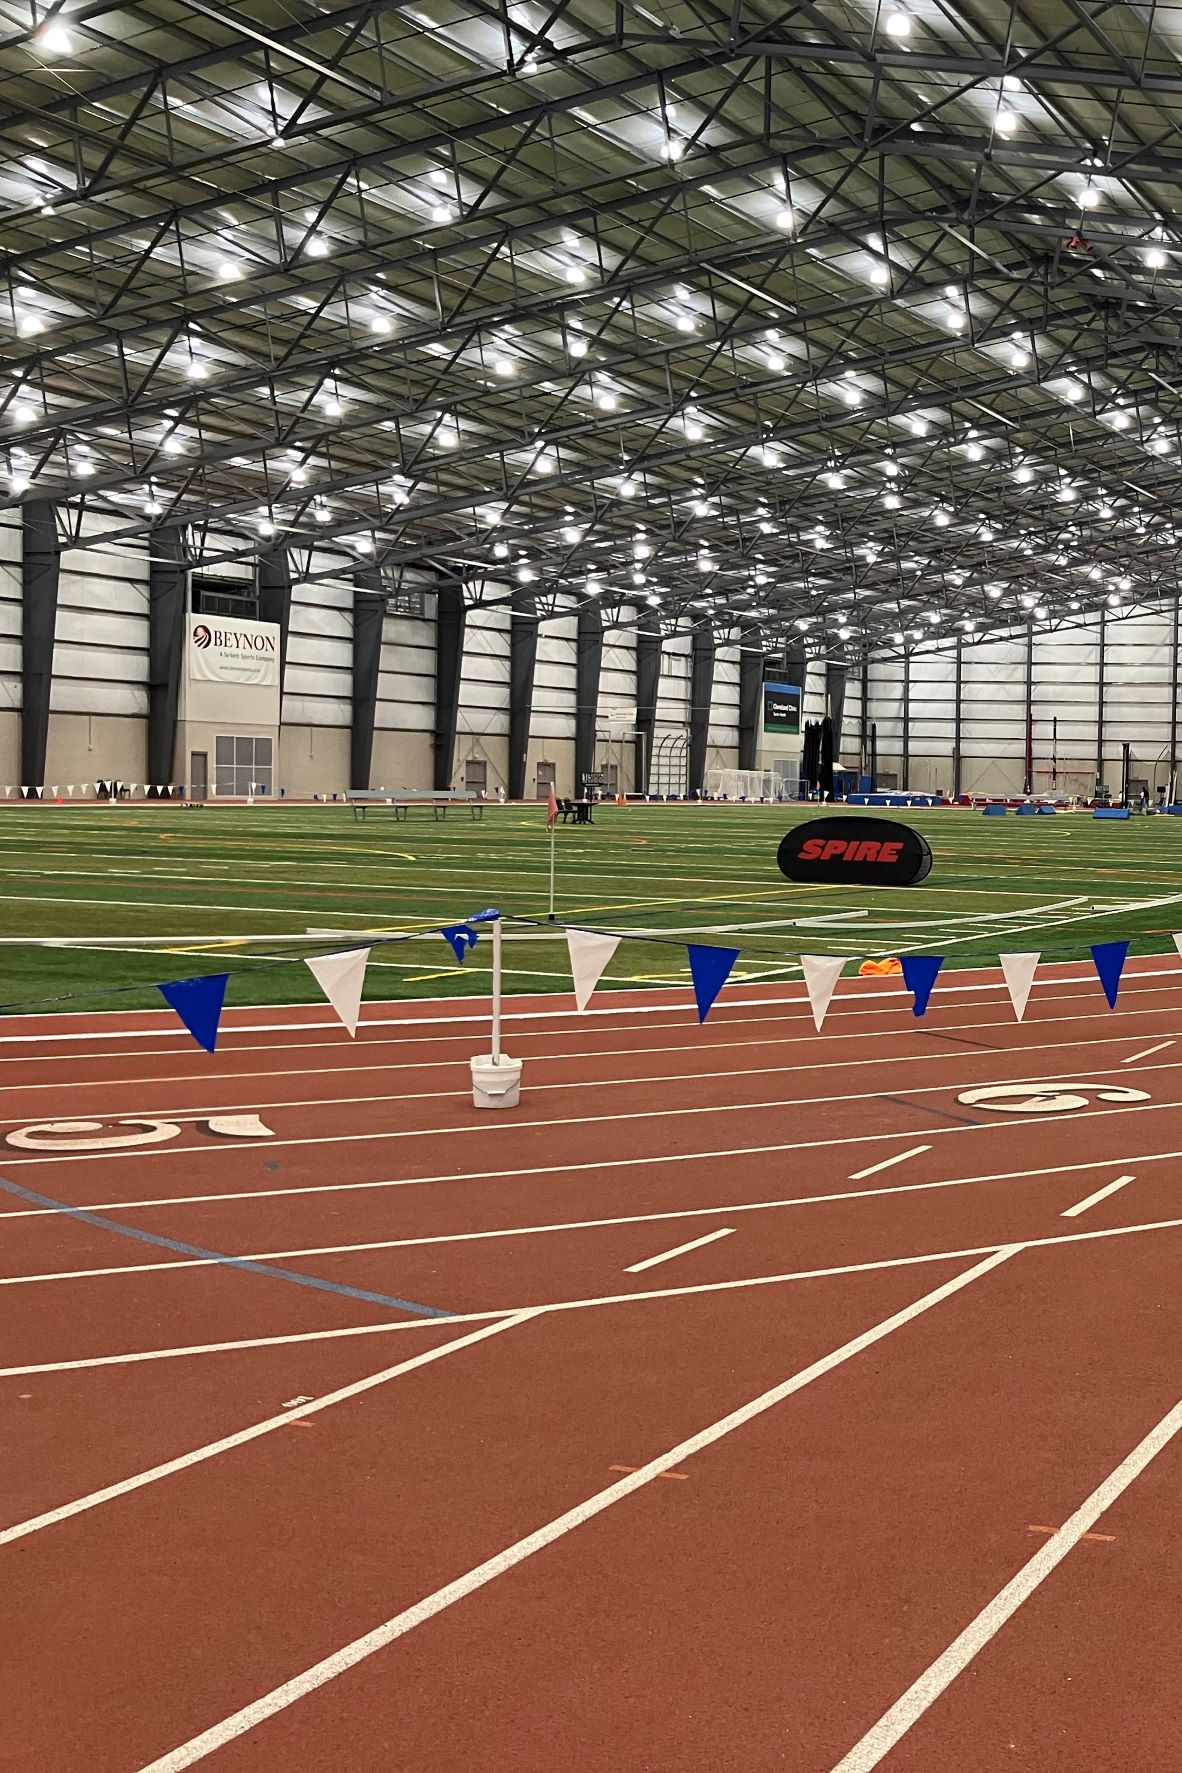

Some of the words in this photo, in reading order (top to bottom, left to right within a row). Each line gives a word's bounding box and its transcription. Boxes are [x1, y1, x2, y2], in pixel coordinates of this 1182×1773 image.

[214, 630, 275, 652] BEYNON
[797, 838, 905, 862] SPIRE
[957, 1082, 1152, 1112] 6
[5, 1114, 276, 1151] 5
